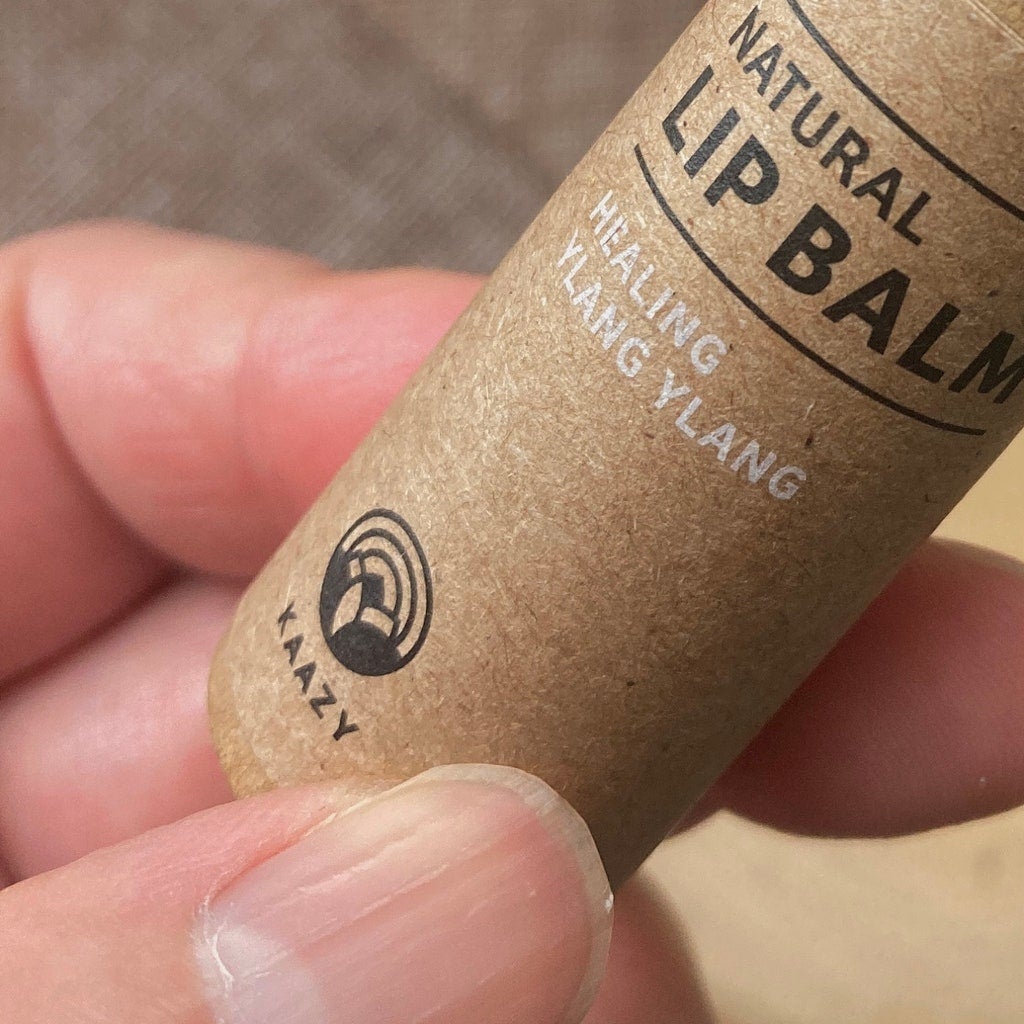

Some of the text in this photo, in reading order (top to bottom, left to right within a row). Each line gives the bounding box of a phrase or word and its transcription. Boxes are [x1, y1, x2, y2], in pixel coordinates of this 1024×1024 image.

[662, 64, 780, 207] LIP
[728, 5, 932, 245] NATURAL
[557, 228, 807, 501] YLANG YLANG
[590, 190, 727, 375] HEALING
[278, 601, 360, 741] KAAZY
